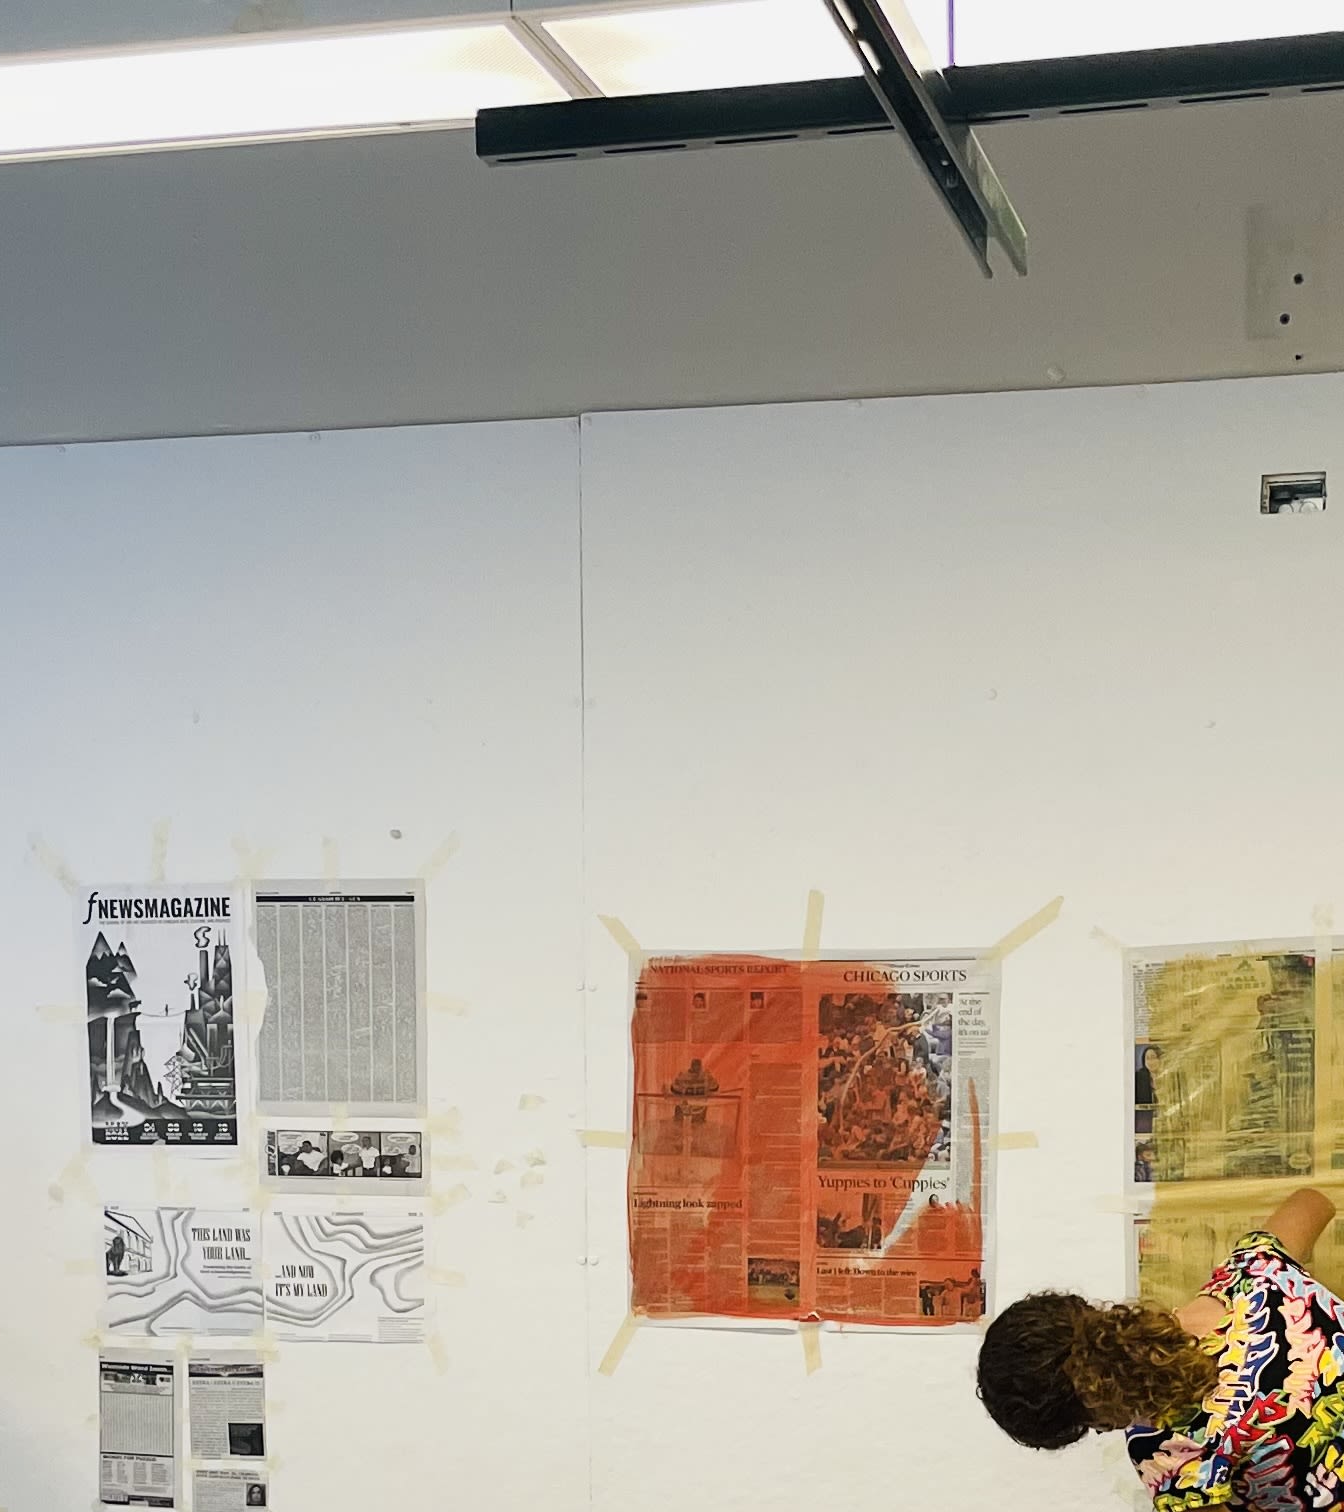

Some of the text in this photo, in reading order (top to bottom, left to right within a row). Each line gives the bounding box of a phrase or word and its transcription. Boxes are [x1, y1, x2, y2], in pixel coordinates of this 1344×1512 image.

[706, 965, 745, 974] SPORTS
[843, 970, 967, 982] CHICAGO SPORTS
[818, 1175, 870, 1191] Yuppies
[873, 1177, 886, 1188] to
[633, 1198, 681, 1210] Lightning
[683, 1198, 704, 1208] look
[212, 1228, 232, 1242] LAND
[235, 1228, 251, 1242] WAS
[293, 1283, 304, 1297] MY
[307, 1283, 327, 1297] LAND
